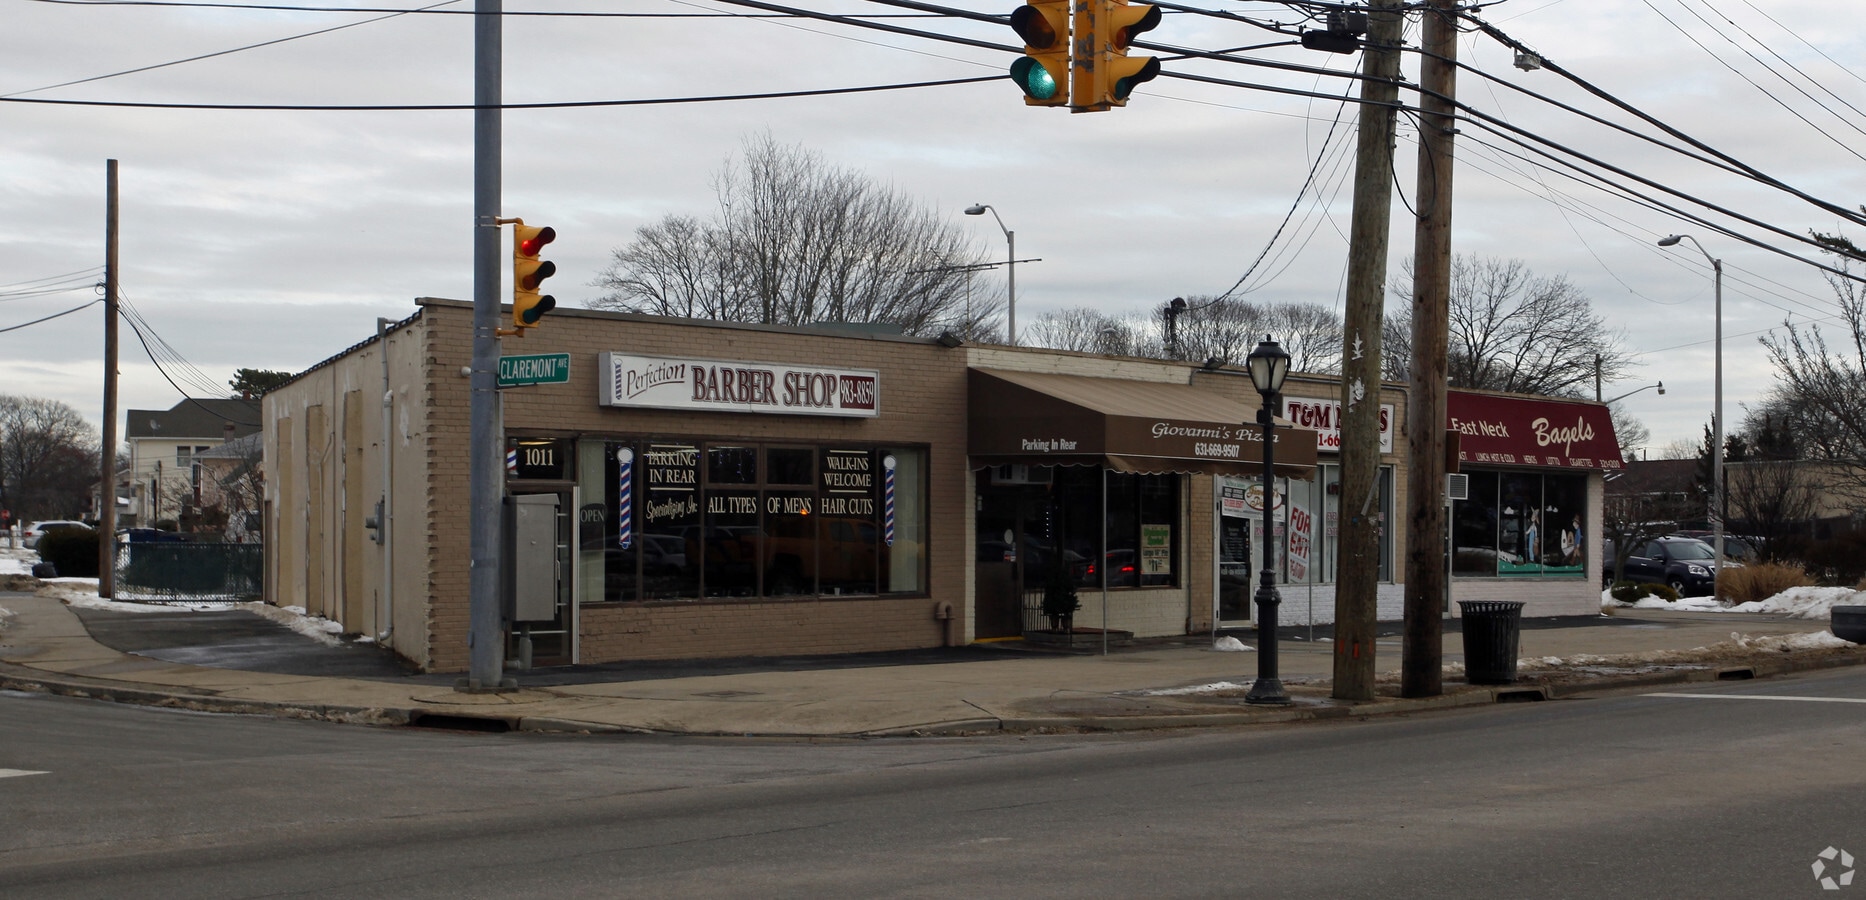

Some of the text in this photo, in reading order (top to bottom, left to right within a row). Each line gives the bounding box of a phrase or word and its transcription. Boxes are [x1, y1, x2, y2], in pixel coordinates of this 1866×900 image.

[500, 358, 568, 380] CLAREMONT AVE
[626, 362, 686, 396] Perfection
[691, 365, 838, 408] BARBER SHOP
[840, 379, 874, 404] 983-8859
[1288, 401, 1331, 430] T&M
[1151, 422, 1231, 439] Giovanni's
[1450, 417, 1510, 438] East Neck
[1531, 415, 1596, 458] Bagels
[1022, 438, 1077, 453] Parking In Rear
[1194, 442, 1240, 458] 631-669-9507
[525, 448, 554, 466] 1011
[648, 452, 697, 467] PARKING
[826, 456, 869, 471] WALK-INS
[1475, 452, 1491, 462] LUNCH
[1522, 454, 1538, 464] HEROS
[1545, 456, 1561, 466] LOTTO
[1569, 457, 1594, 467] CIGARETTES
[650, 469, 696, 484] IN REAR
[824, 472, 872, 487] WELCOME
[646, 496, 685, 524] Specializing
[708, 497, 873, 515] ALL TYPES OF MENS HAIR CUTS
[580, 509, 605, 523] OPEN
[1290, 506, 1310, 534] FOR
